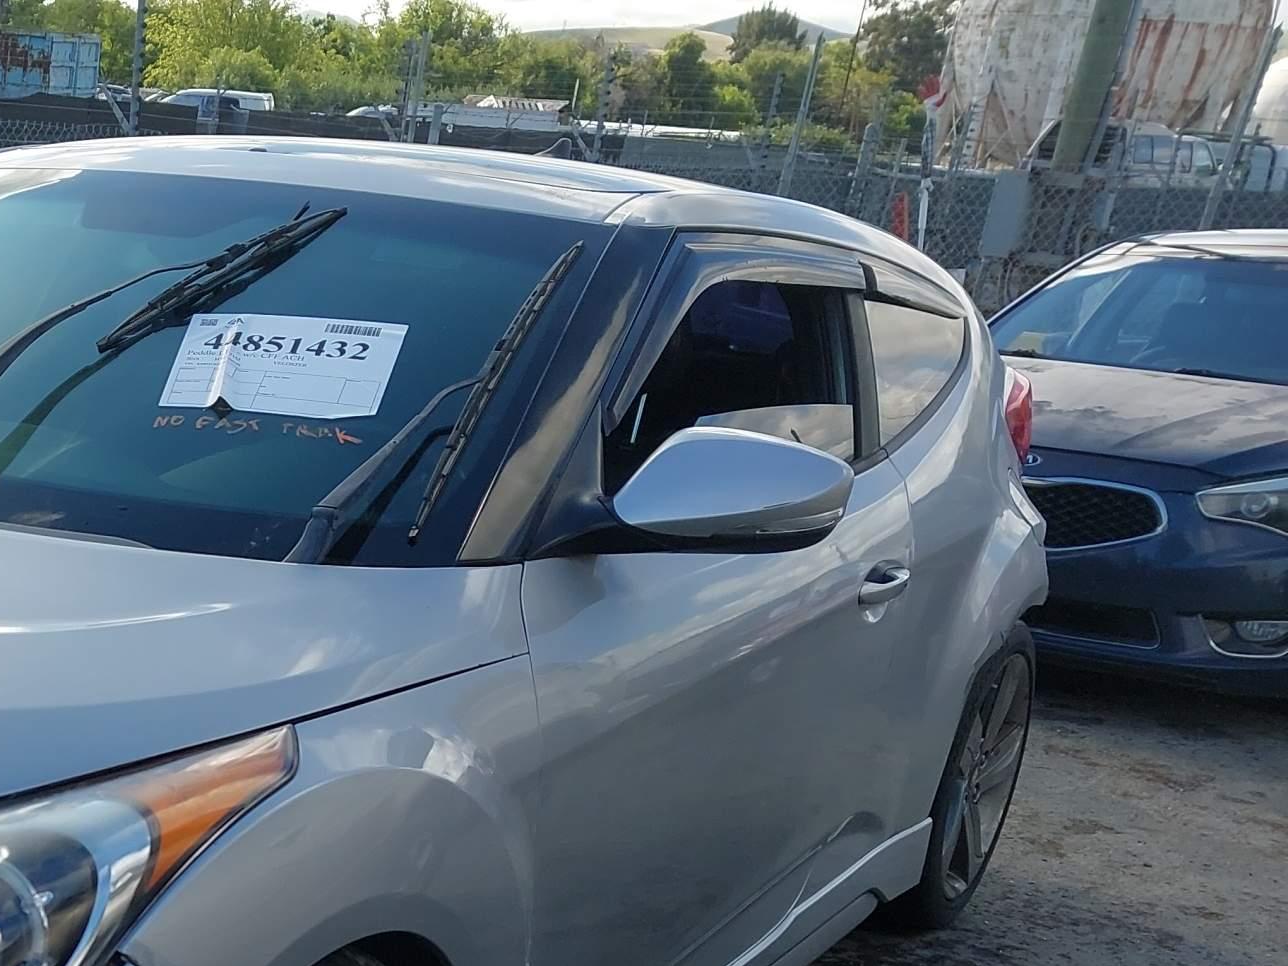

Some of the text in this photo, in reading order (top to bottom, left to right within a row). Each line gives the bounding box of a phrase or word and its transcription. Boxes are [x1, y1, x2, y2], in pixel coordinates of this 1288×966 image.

[203, 331, 370, 361] 44851432
[153, 415, 185, 429] NO
[195, 416, 262, 434] FAST
